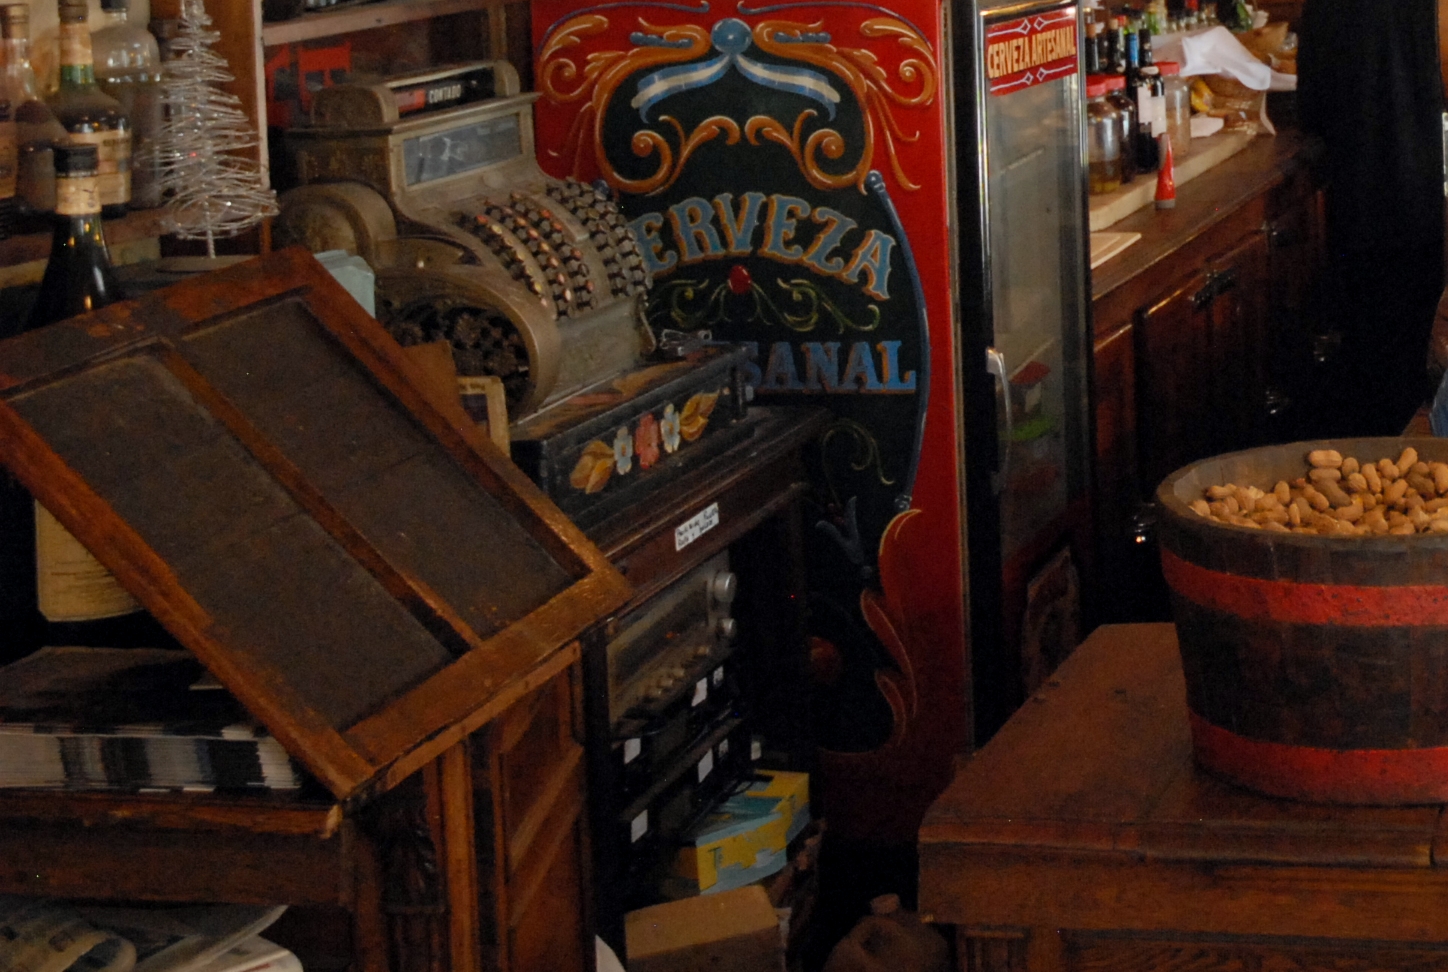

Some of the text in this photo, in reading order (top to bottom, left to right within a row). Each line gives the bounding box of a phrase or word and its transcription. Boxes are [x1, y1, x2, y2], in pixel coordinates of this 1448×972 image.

[987, 25, 1077, 79] CERVEZA ARTESANAL
[428, 83, 462, 104] CONTADO
[632, 191, 897, 301] ERVEZA
[738, 339, 917, 395] SANAL
